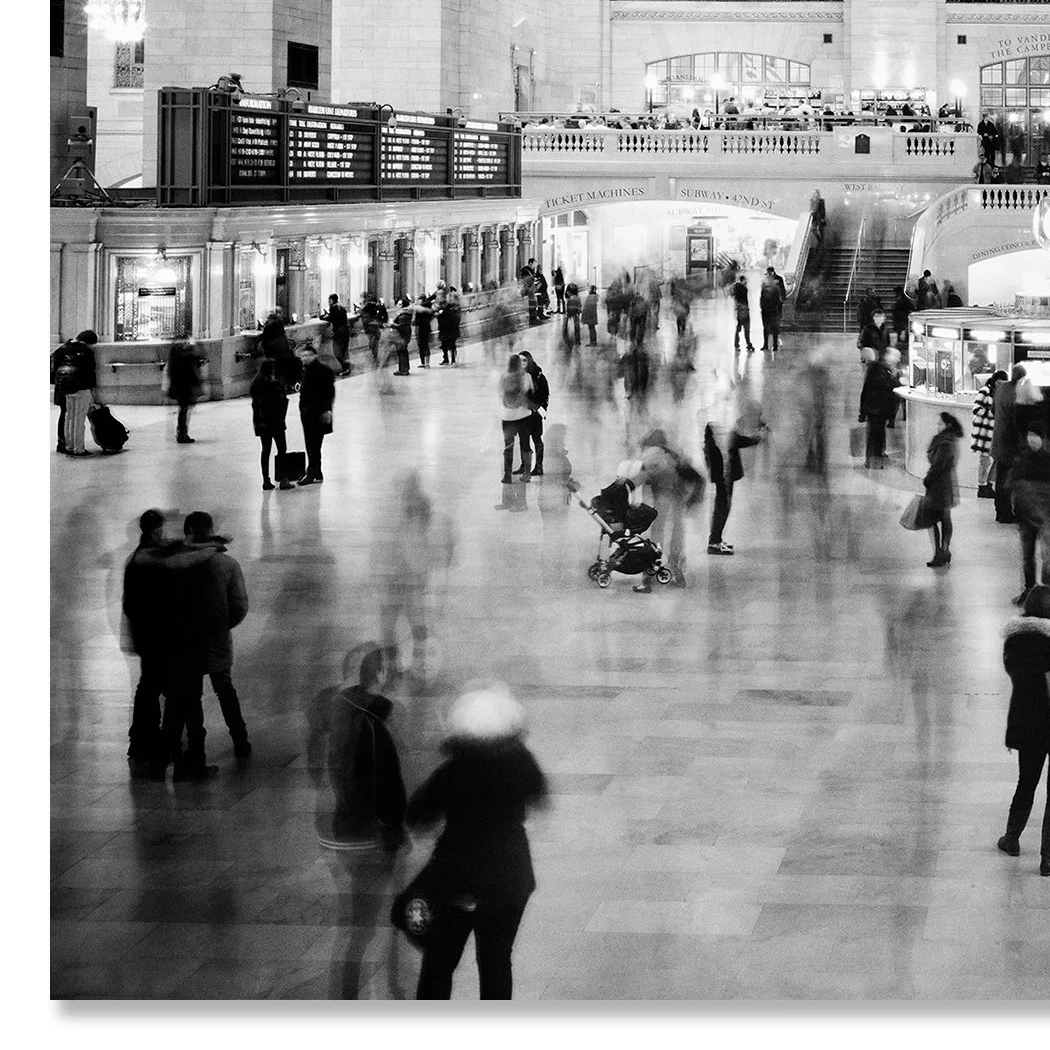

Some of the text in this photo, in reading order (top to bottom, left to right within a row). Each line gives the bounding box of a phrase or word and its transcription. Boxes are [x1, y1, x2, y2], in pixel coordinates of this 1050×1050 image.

[998, 38, 1012, 48] TO
[989, 47, 1011, 59] THE
[545, 188, 645, 208] TICKET MACHINES
[680, 189, 776, 210] SUBWAY 42ND ST
[972, 246, 1000, 260] DINING
